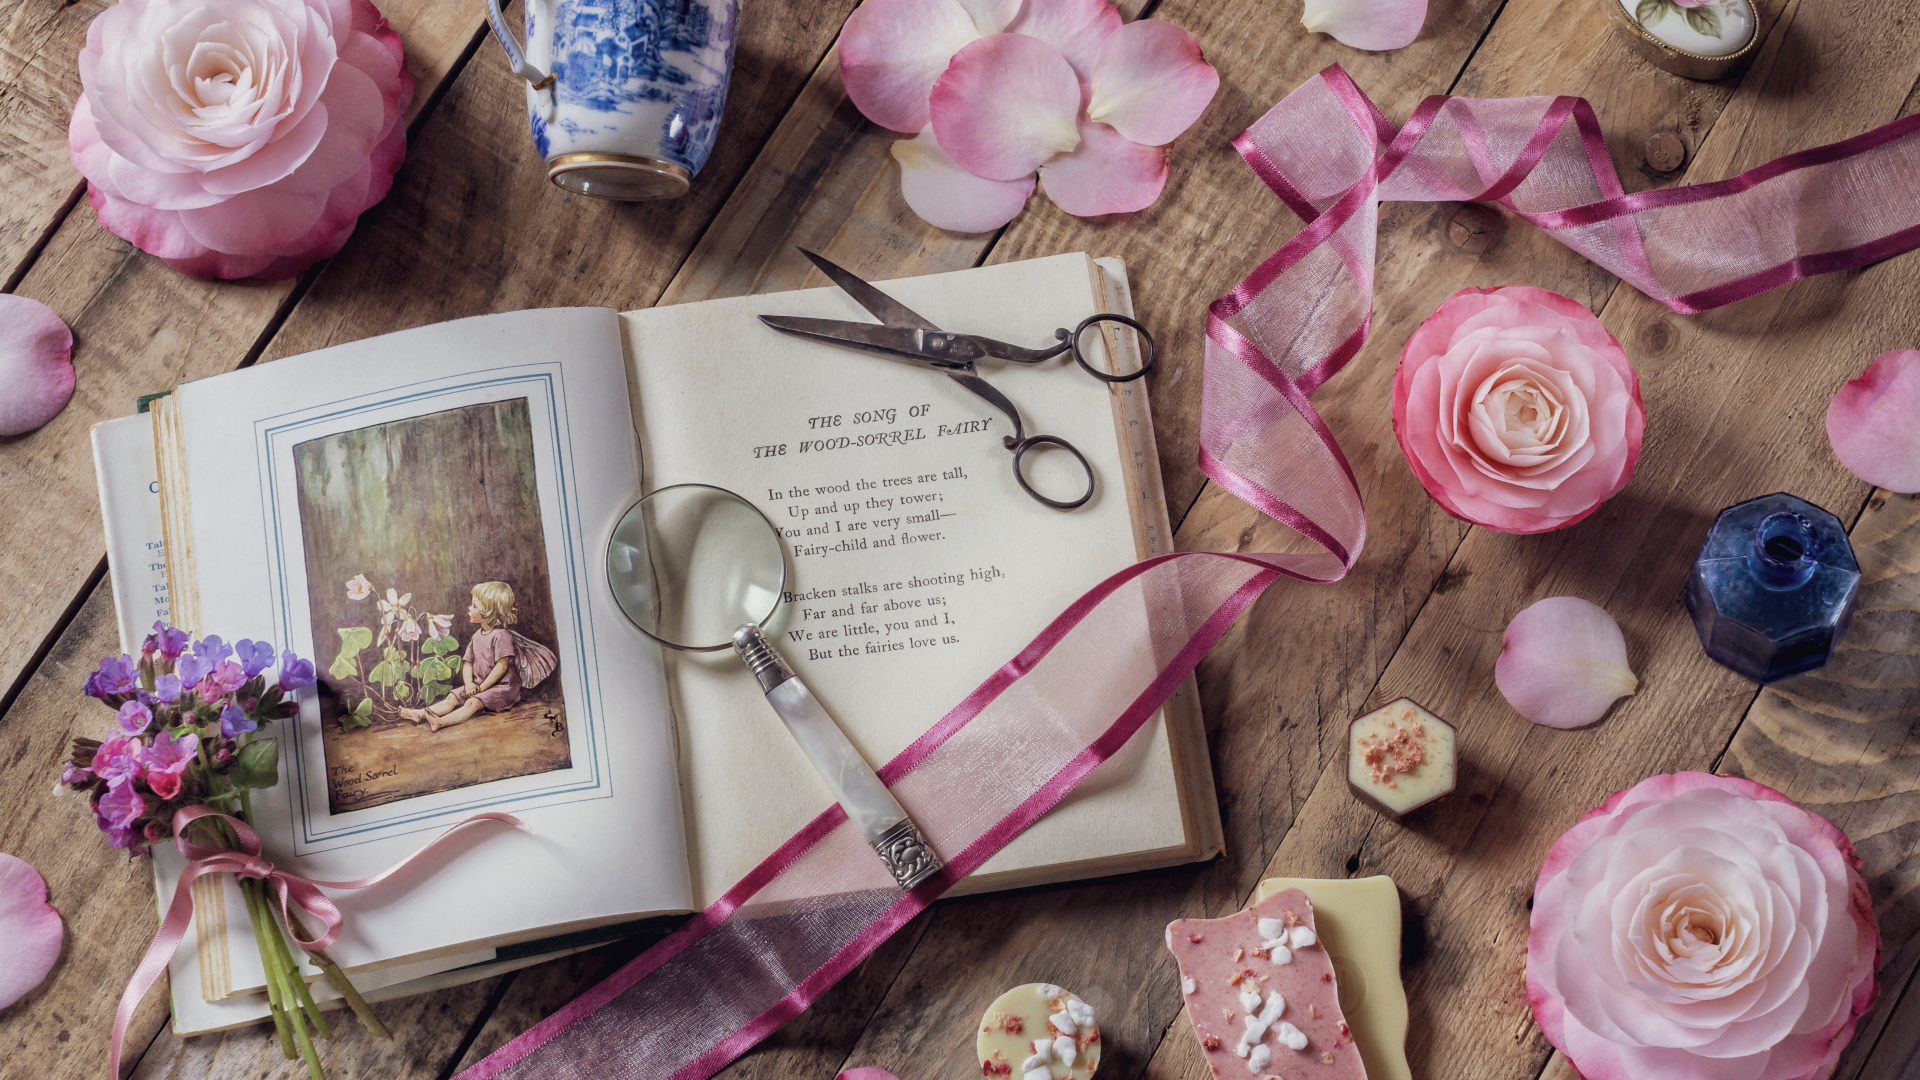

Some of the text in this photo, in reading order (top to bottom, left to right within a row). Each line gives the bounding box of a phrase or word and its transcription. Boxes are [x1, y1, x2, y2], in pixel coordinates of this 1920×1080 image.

[807, 403, 931, 430] THE SONG OF
[752, 417, 993, 459] THE WOOD-SORREL FAIRY
[767, 466, 968, 501] In the wood the trees are tall,
[787, 492, 944, 521] Up and up they tower;
[775, 526, 801, 539] You
[806, 521, 830, 536] and
[834, 520, 842, 533] I
[847, 521, 868, 532] are
[872, 517, 901, 531] very
[793, 532, 946, 559] Fairy-child and flower.
[783, 587, 837, 604] Bracken
[841, 581, 879, 597] stalks
[882, 581, 903, 592] are
[907, 572, 965, 589] shooting
[802, 596, 947, 622] Far and far above us;
[787, 611, 956, 643] We are little, you and I,
[808, 635, 960, 661] But the fairies love us.
[331, 764, 354, 776] The
[333, 764, 398, 789] Wood Sorrel
